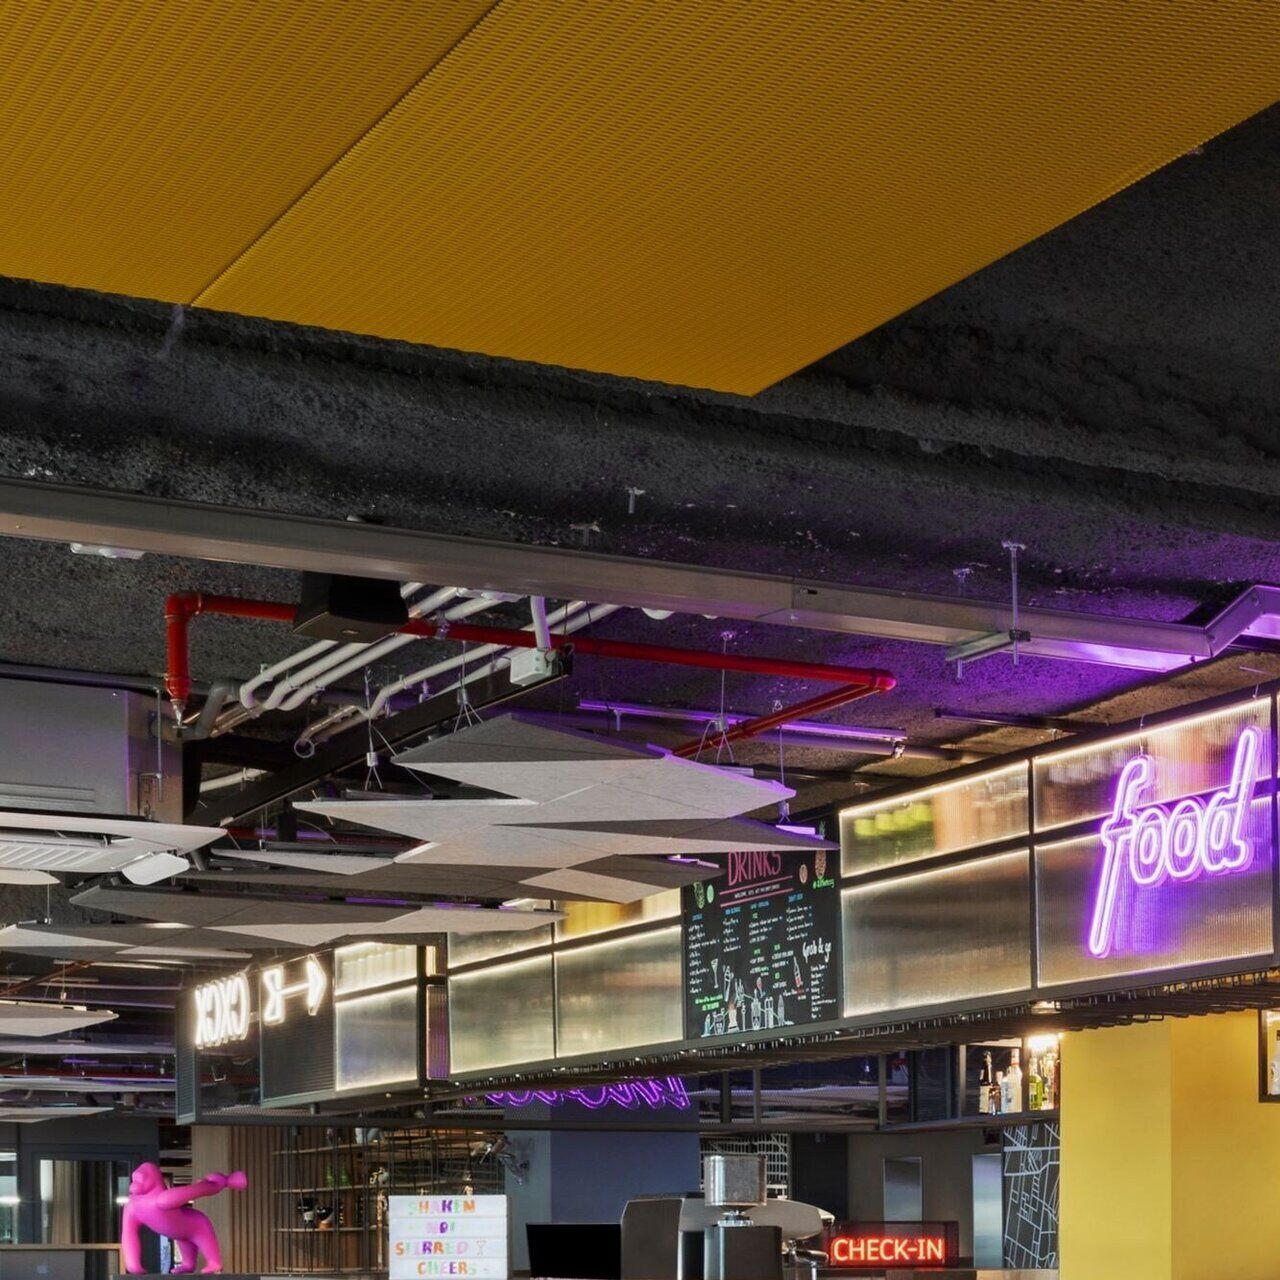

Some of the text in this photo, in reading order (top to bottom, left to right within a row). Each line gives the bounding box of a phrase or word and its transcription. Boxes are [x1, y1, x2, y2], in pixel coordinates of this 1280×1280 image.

[1089, 727, 1258, 957] food
[728, 851, 782, 886] DRINKS
[407, 1199, 476, 1213] SHAKEN
[833, 1238, 943, 1261] CHECK-IN
[417, 1261, 478, 1276] CHEERS
